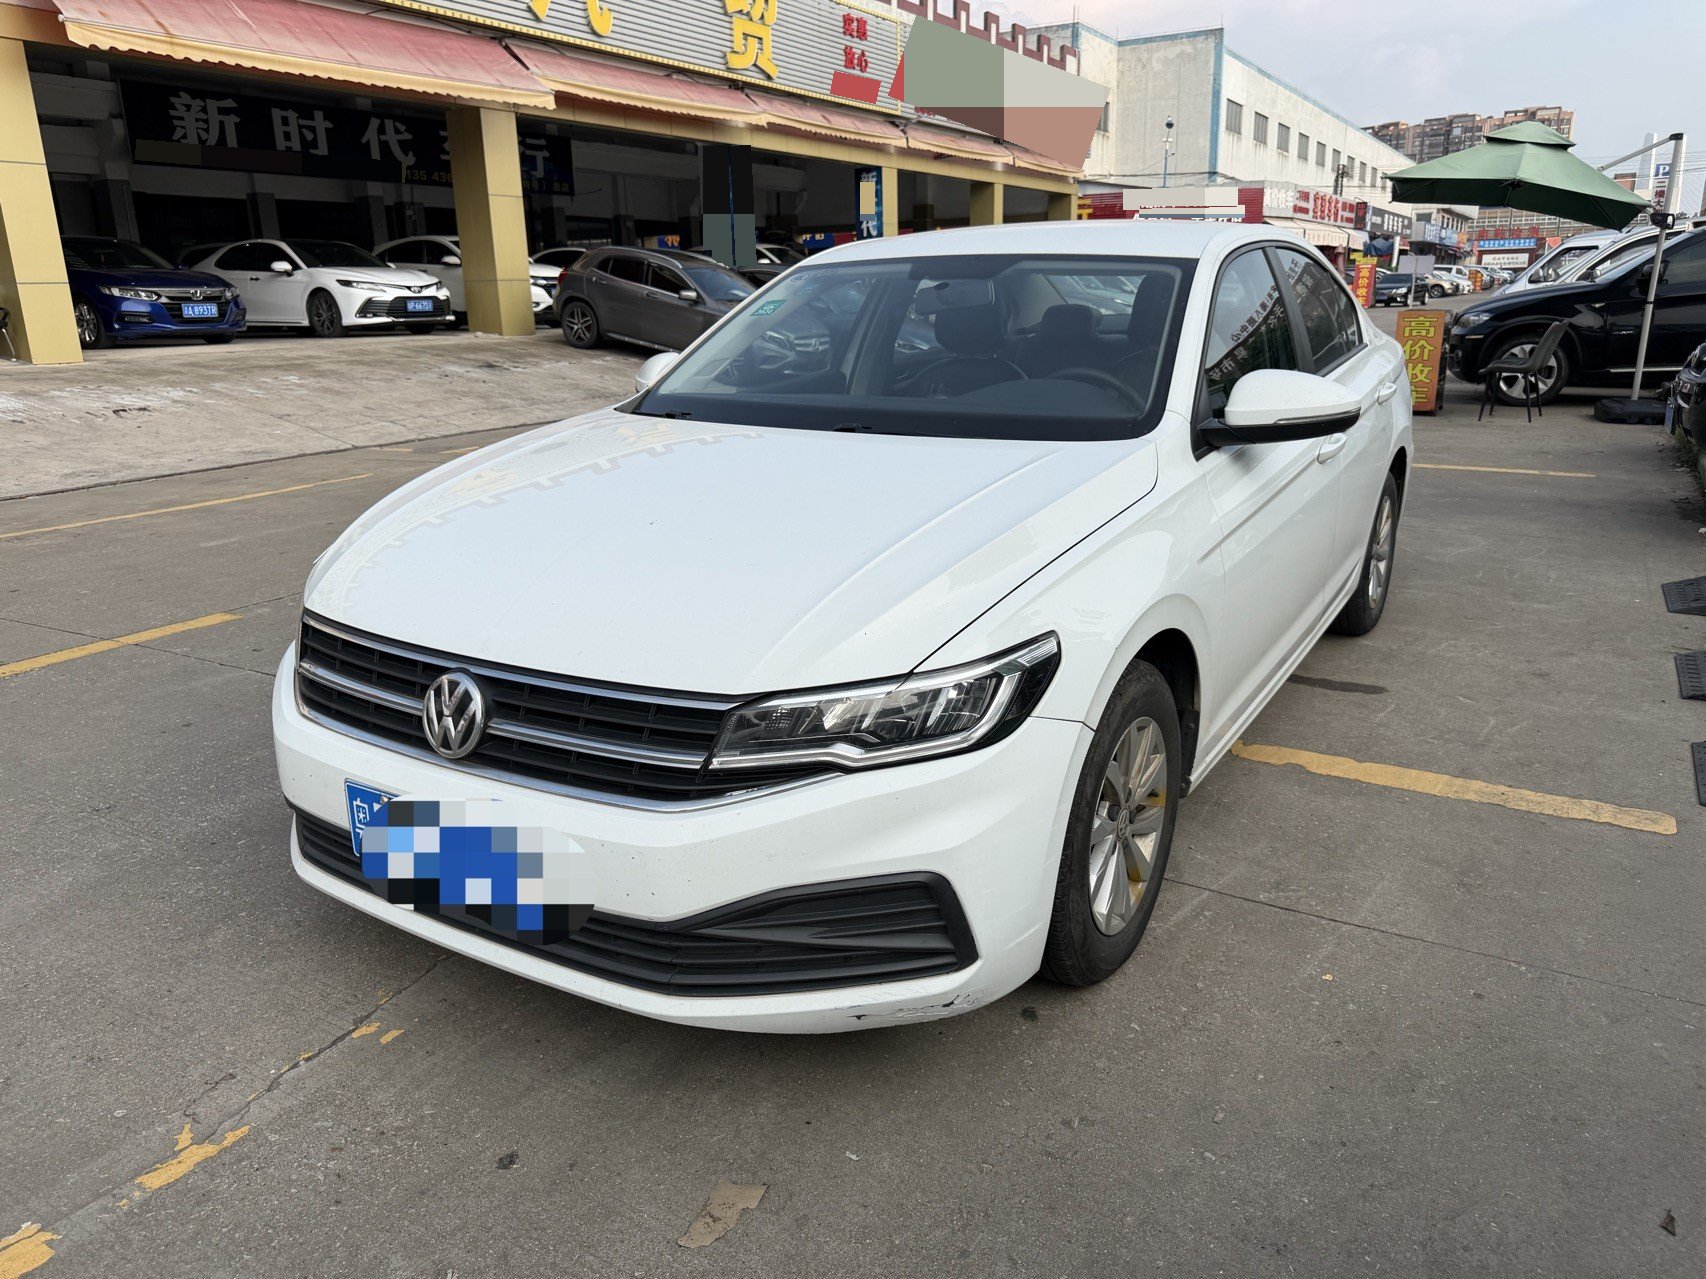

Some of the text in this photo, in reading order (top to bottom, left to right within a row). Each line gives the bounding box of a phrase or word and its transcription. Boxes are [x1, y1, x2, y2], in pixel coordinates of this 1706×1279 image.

[843, 13, 868, 41] 实惠
[844, 46, 869, 73] 放心
[1658, 165, 1670, 178] P
[1403, 316, 1438, 406] 高价收车
